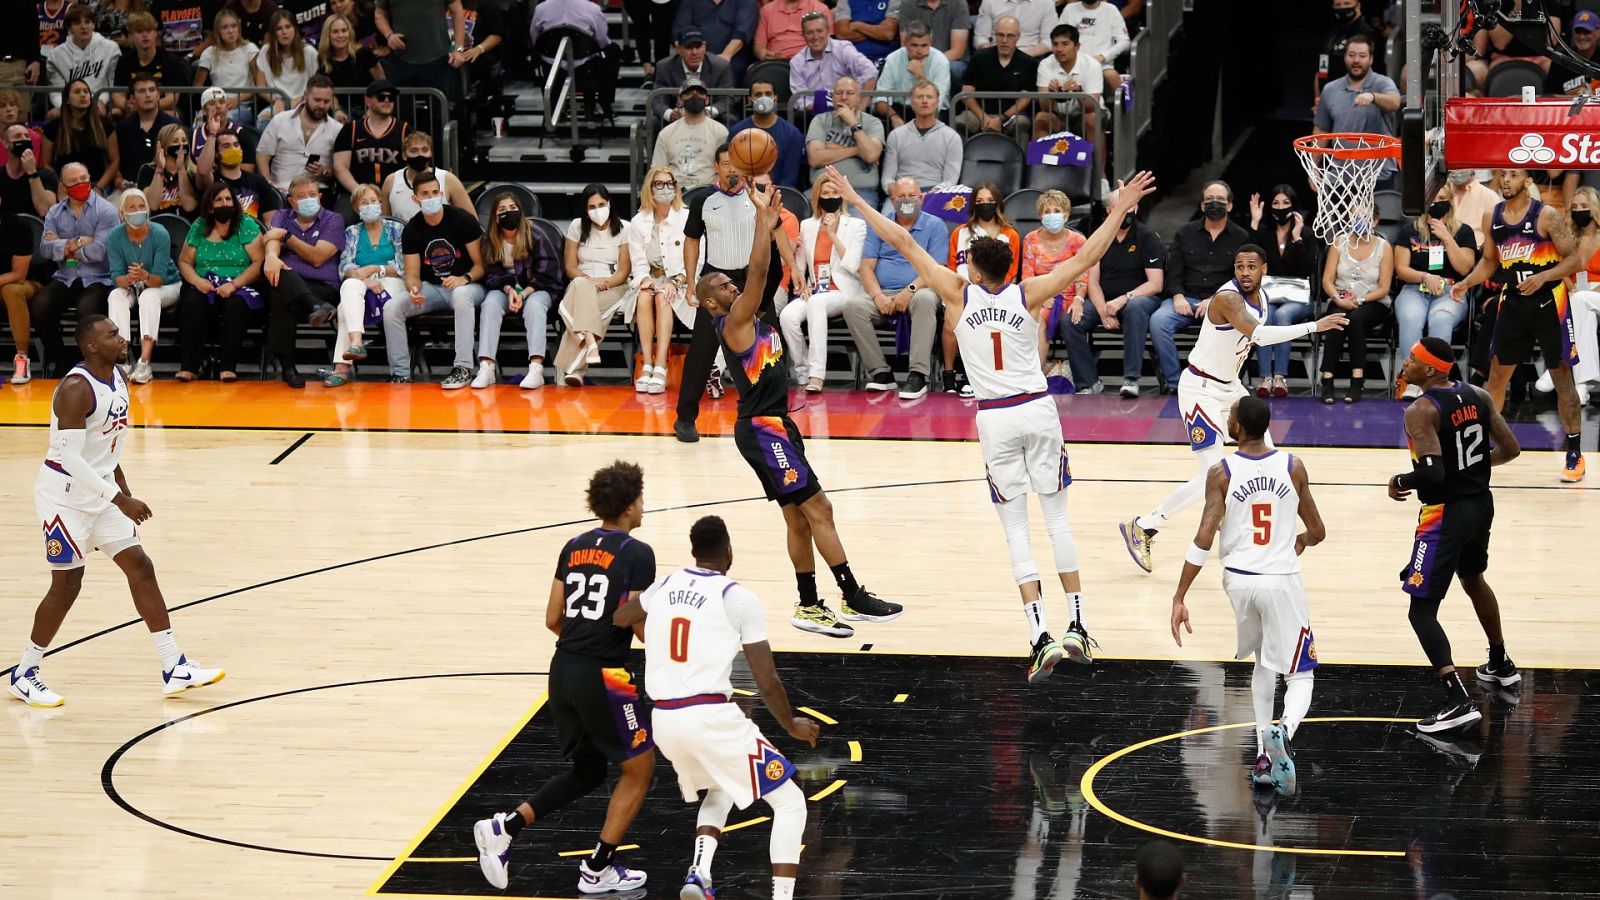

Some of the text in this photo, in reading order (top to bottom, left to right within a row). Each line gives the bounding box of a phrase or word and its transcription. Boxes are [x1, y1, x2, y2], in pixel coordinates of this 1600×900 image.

[296, 3, 326, 24] SUNS
[1563, 75, 1586, 92] SUN
[356, 147, 399, 164] PHX
[1559, 133, 1600, 164] Sta
[1497, 242, 1536, 260] Valley
[966, 307, 1025, 331] PORTER JR.
[990, 332, 1004, 371] 1
[1451, 404, 1478, 427] CRAIG
[1455, 423, 1484, 471] 12
[1232, 476, 1291, 503] BARTON III
[1252, 503, 1272, 546] 5
[567, 548, 615, 570] JOHNSON
[565, 572, 610, 621] 23
[668, 590, 708, 610] GREEN
[670, 616, 691, 663] 0
